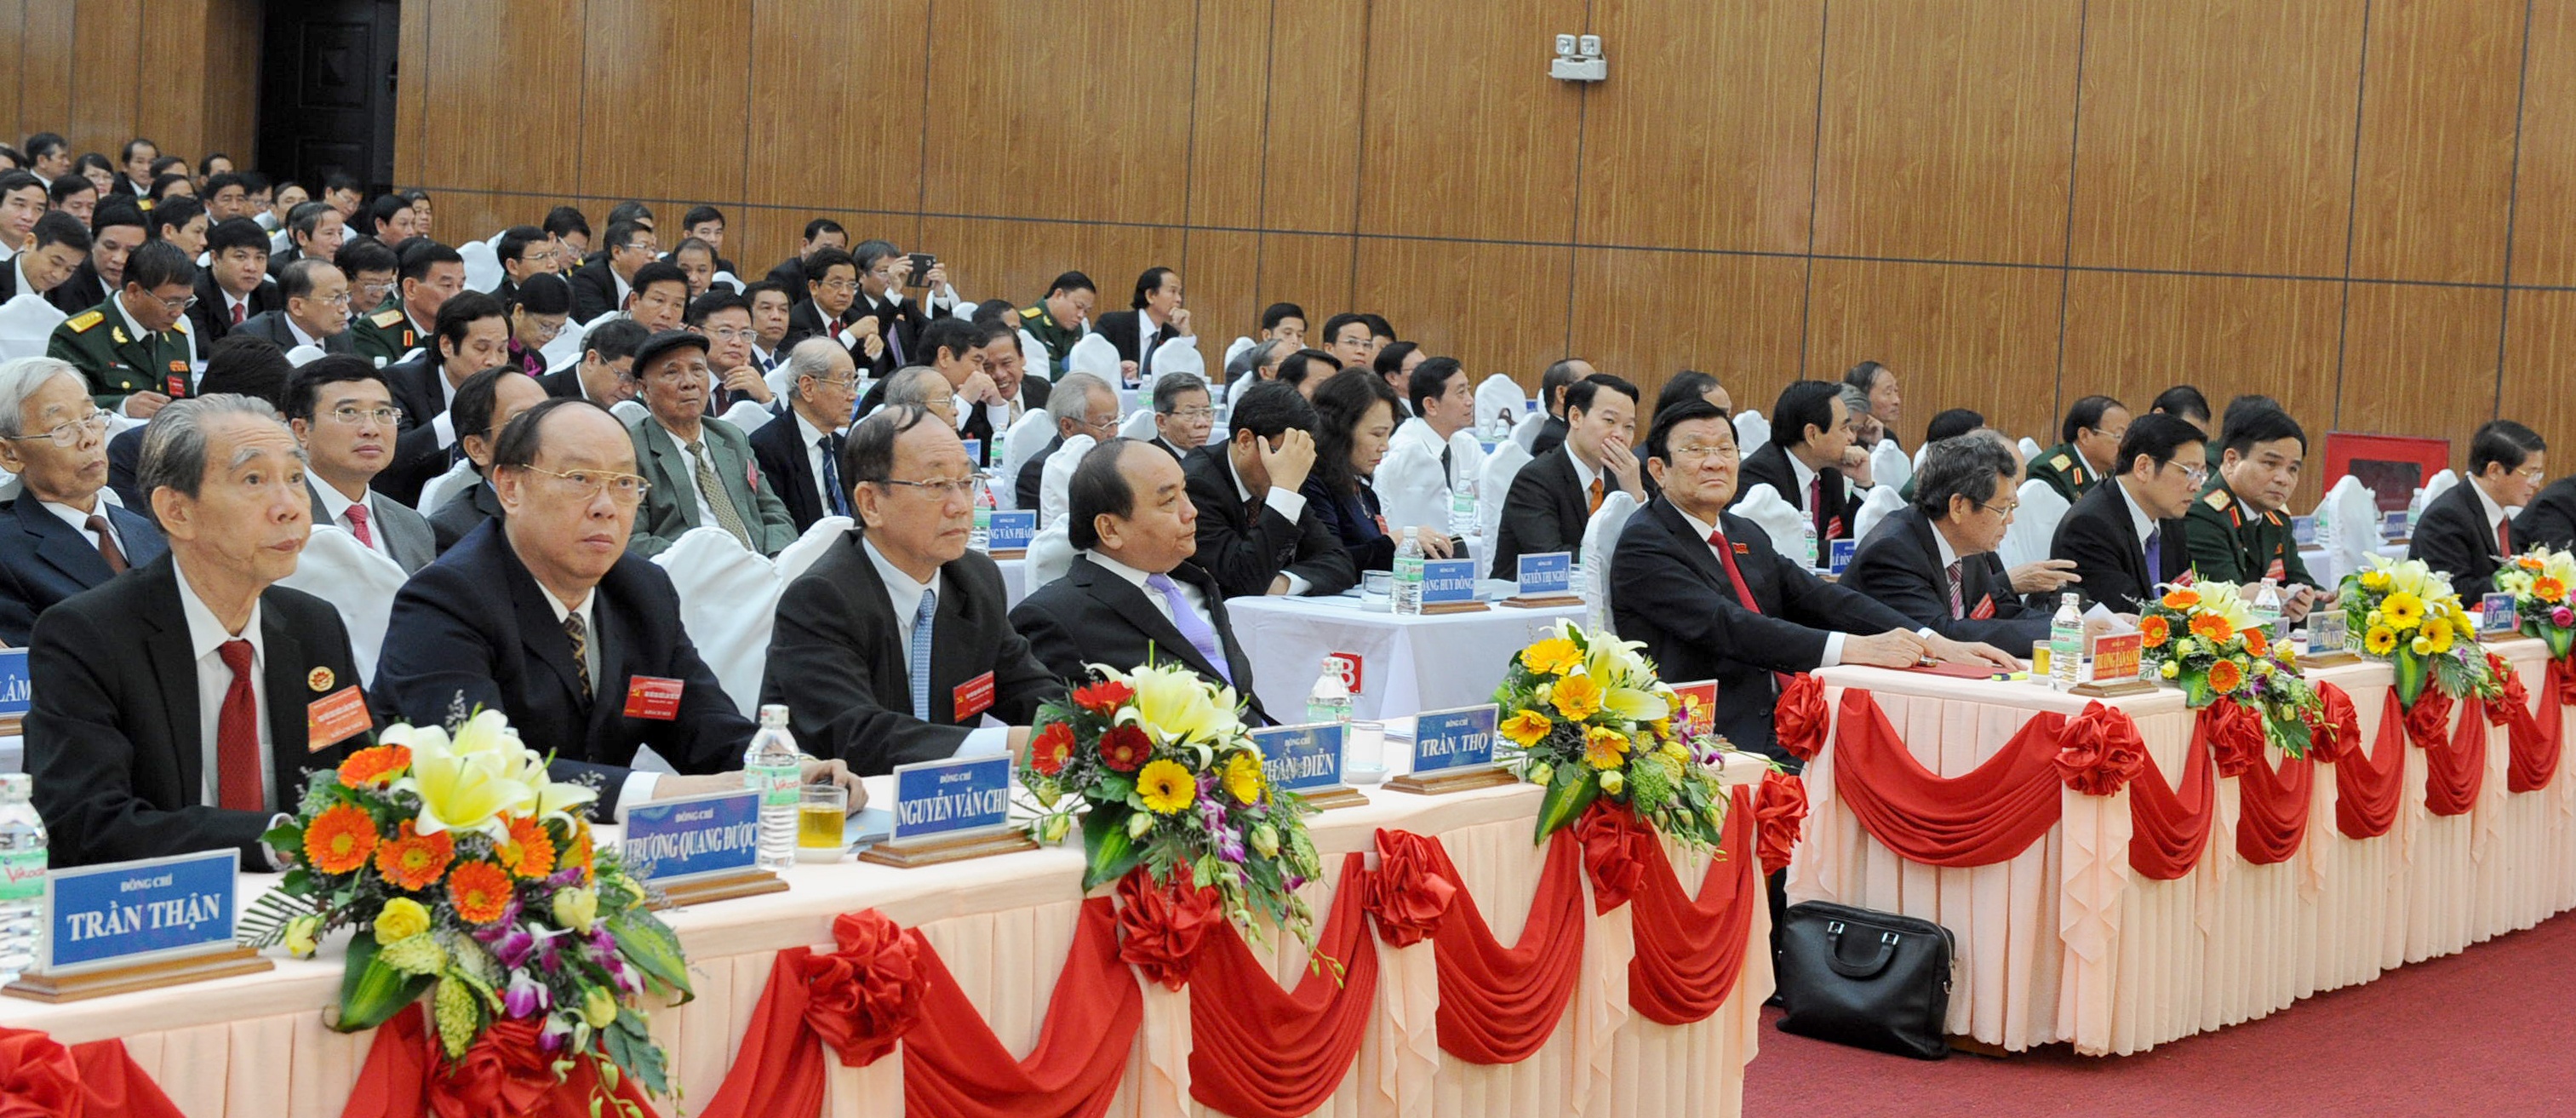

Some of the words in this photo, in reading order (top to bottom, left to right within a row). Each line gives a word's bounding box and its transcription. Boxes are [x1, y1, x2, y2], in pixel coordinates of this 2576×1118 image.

[1421, 732, 1457, 758] TRẦN
[1461, 732, 1488, 754] THỌ
[896, 788, 953, 826] NGUYỄN
[955, 786, 983, 818] VĂN
[680, 827, 723, 862] QUANG
[724, 821, 758, 855] ĐƯỢC
[66, 901, 143, 942] TRẦN
[147, 892, 222, 931] THẬN
